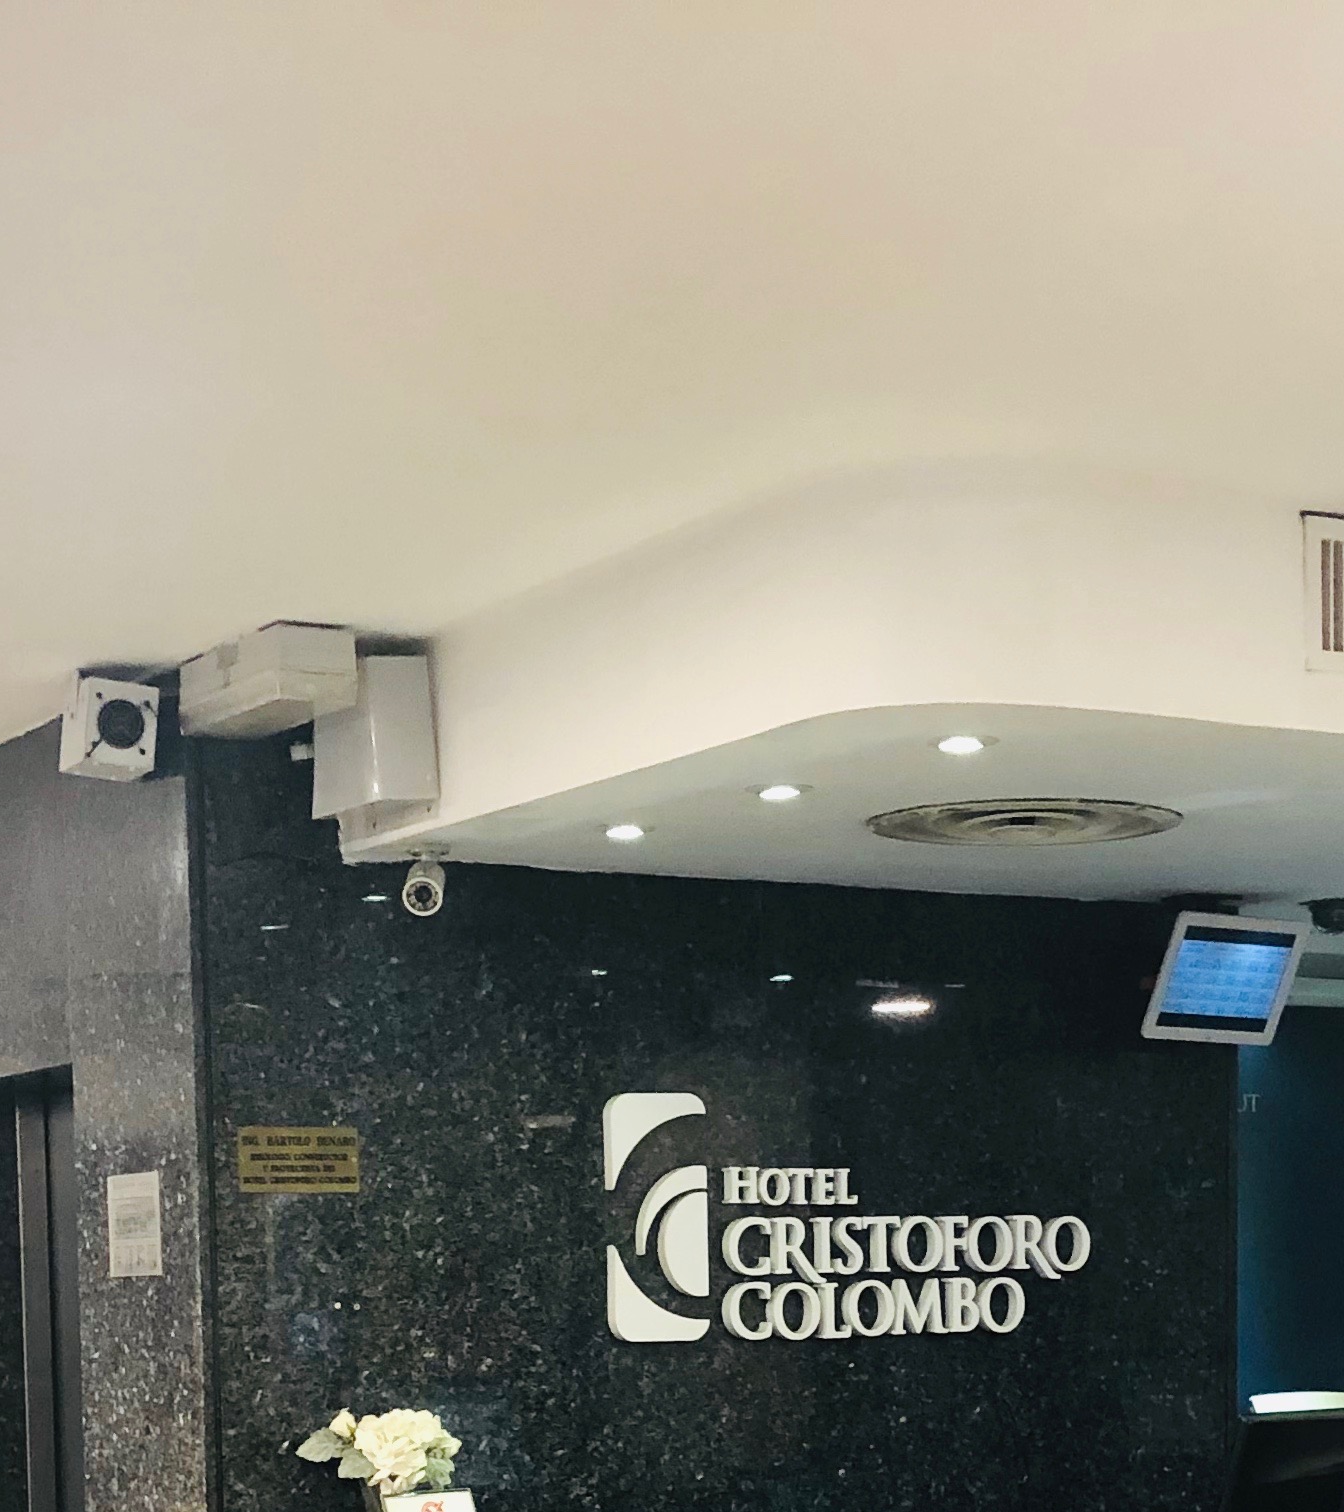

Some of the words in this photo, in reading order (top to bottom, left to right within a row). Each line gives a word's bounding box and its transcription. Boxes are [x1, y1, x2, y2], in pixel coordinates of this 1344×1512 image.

[721, 1165, 858, 1206] HOTEL
[721, 1214, 1091, 1284] CRISTOFORO
[721, 1276, 1026, 1341] COLOMBO
